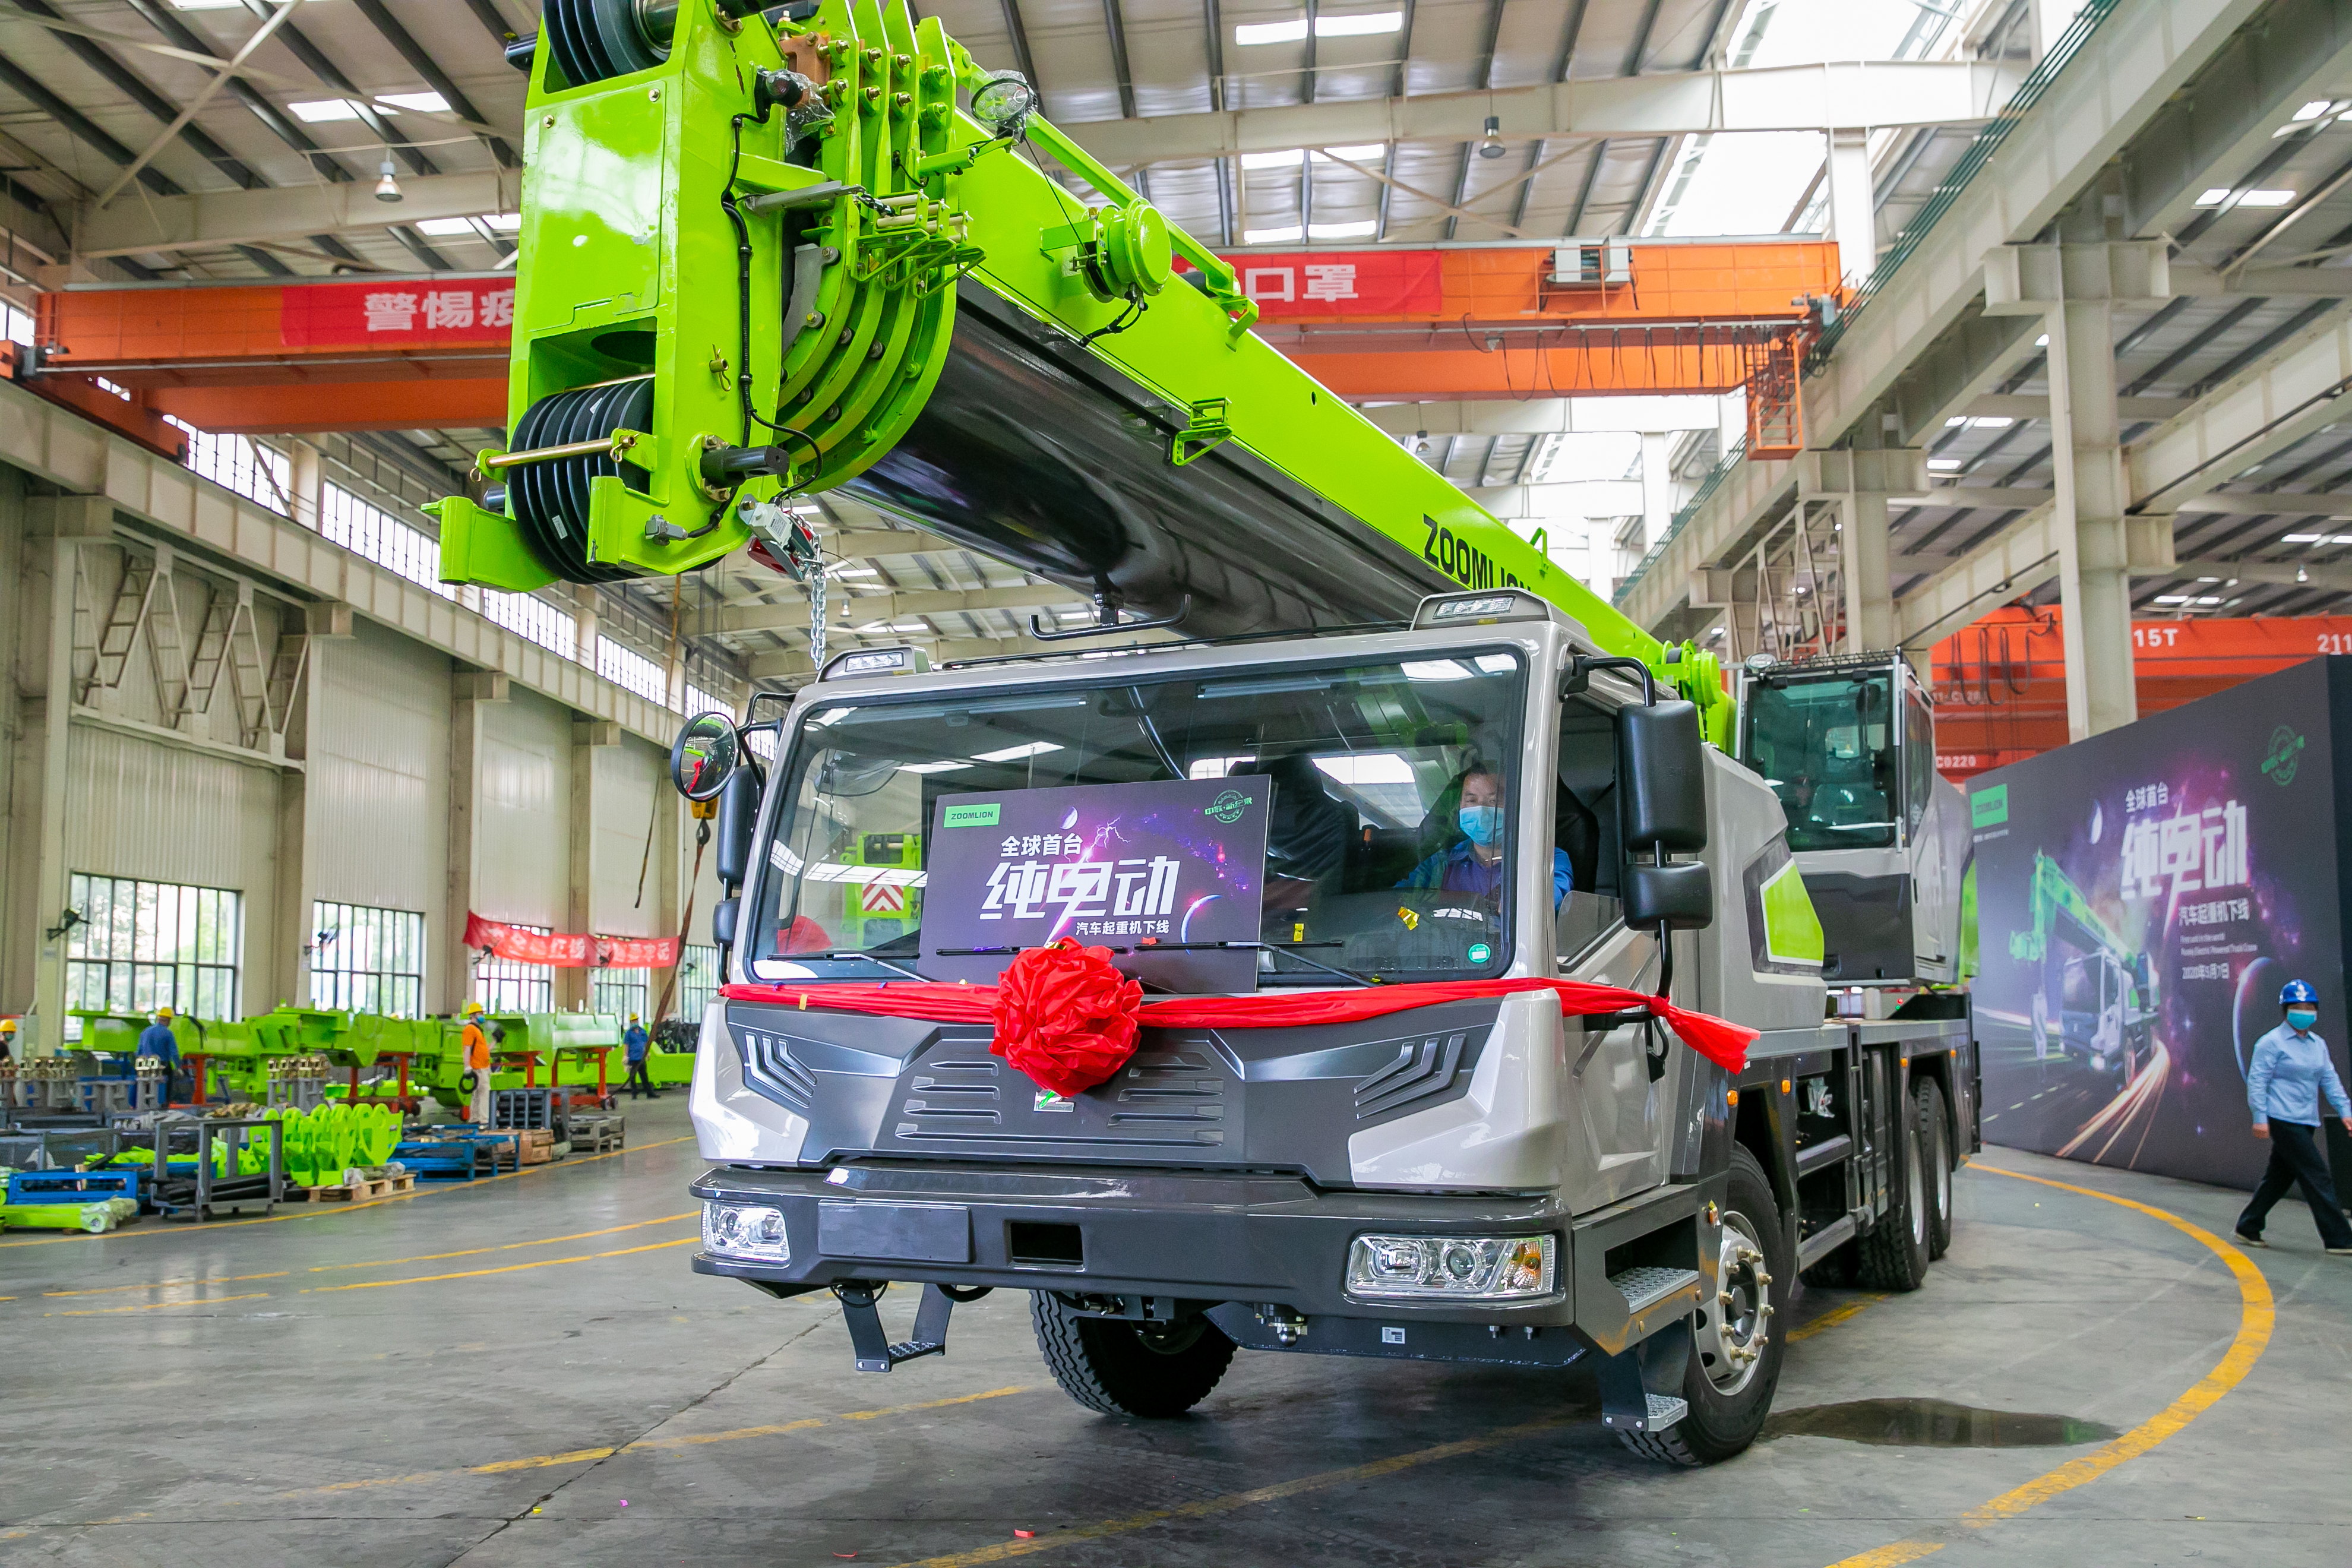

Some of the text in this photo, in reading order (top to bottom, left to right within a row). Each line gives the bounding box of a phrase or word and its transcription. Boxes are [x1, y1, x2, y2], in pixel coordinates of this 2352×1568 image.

[364, 264, 1358, 331] 警惕疫 口罩
[1423, 513, 1531, 592] ZOOMLI
[2133, 628, 2179, 647] 15T
[2317, 633, 2352, 654] 211
[1936, 754, 1977, 769] C0220
[2126, 782, 2168, 814] 全球首台
[951, 811, 994, 820] ZOOMLION
[1000, 833, 1083, 857] 全球首台
[2120, 799, 2247, 900] 纯电动
[979, 855, 1181, 920] 纯电动
[1076, 920, 1169, 936] 汽车起重机下线
